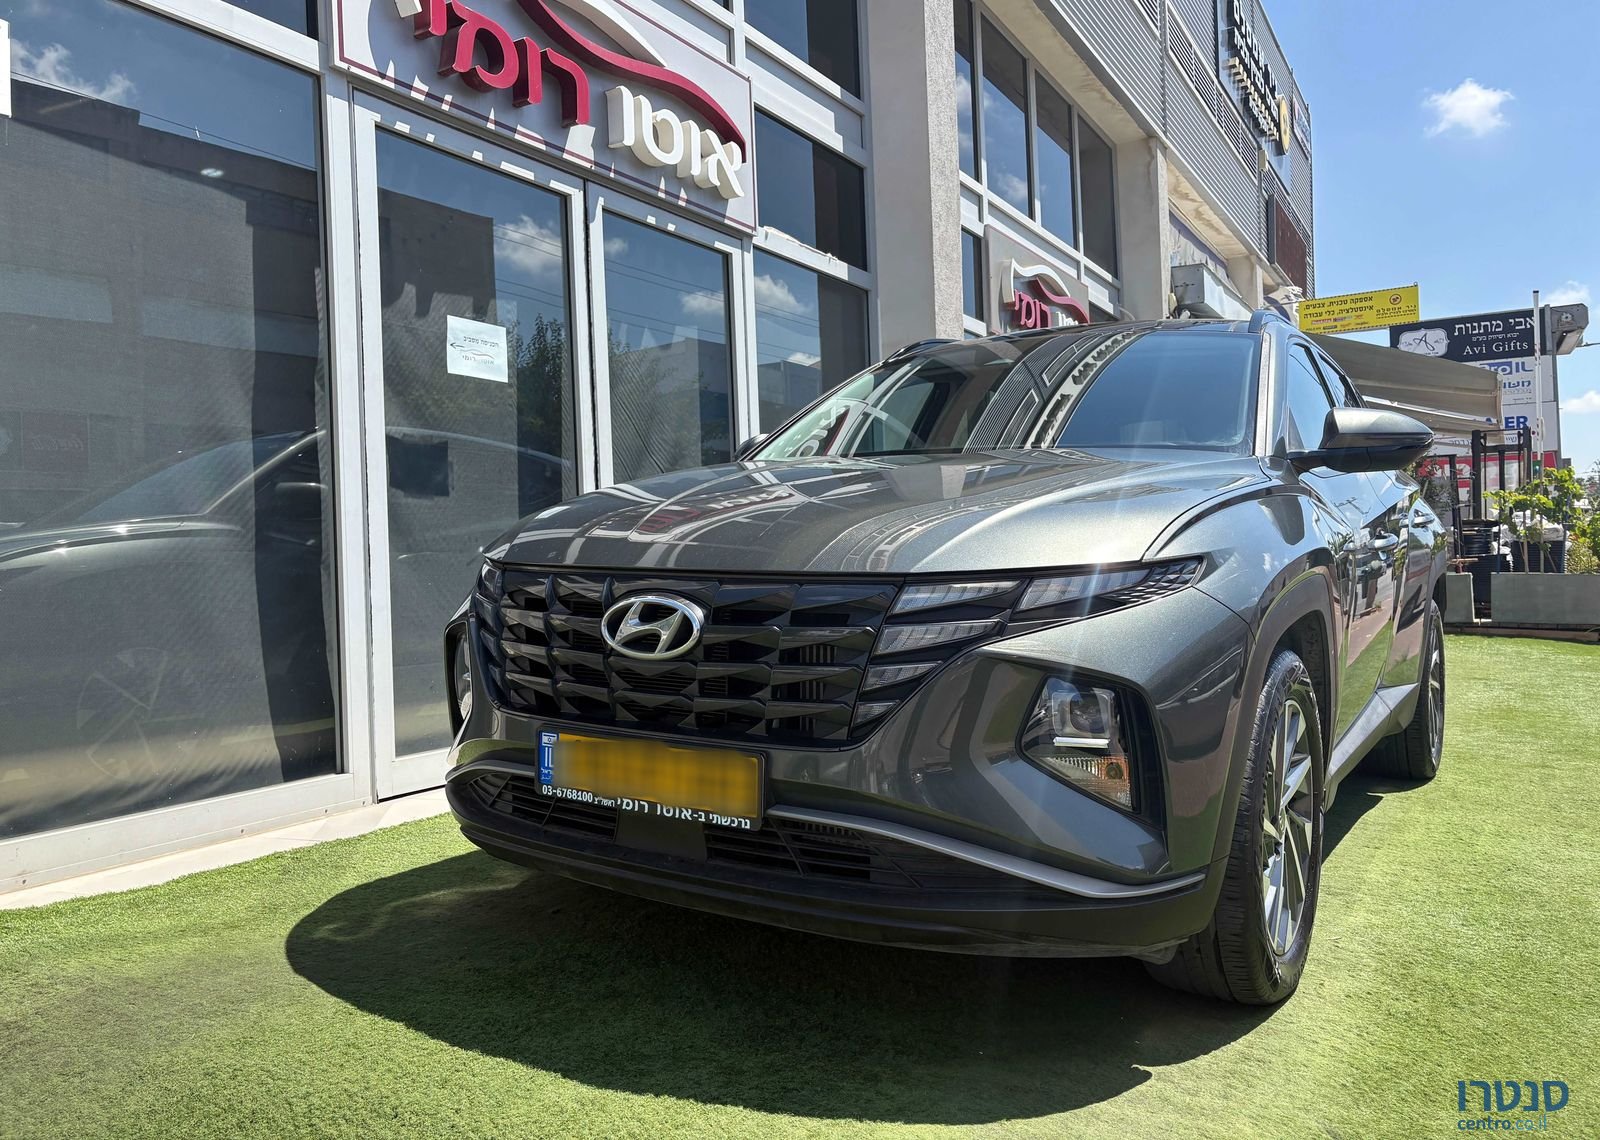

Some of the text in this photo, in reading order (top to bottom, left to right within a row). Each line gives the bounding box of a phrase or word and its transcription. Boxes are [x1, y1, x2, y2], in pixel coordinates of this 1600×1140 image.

[606, 85, 745, 199] אוטו
[1349, 296, 1374, 305] אספקה
[1453, 320, 1503, 336] מתנות
[1463, 341, 1529, 355] Avi Gifts
[542, 784, 593, 803] 03-6768100
[709, 812, 751, 829] נרכשתי
